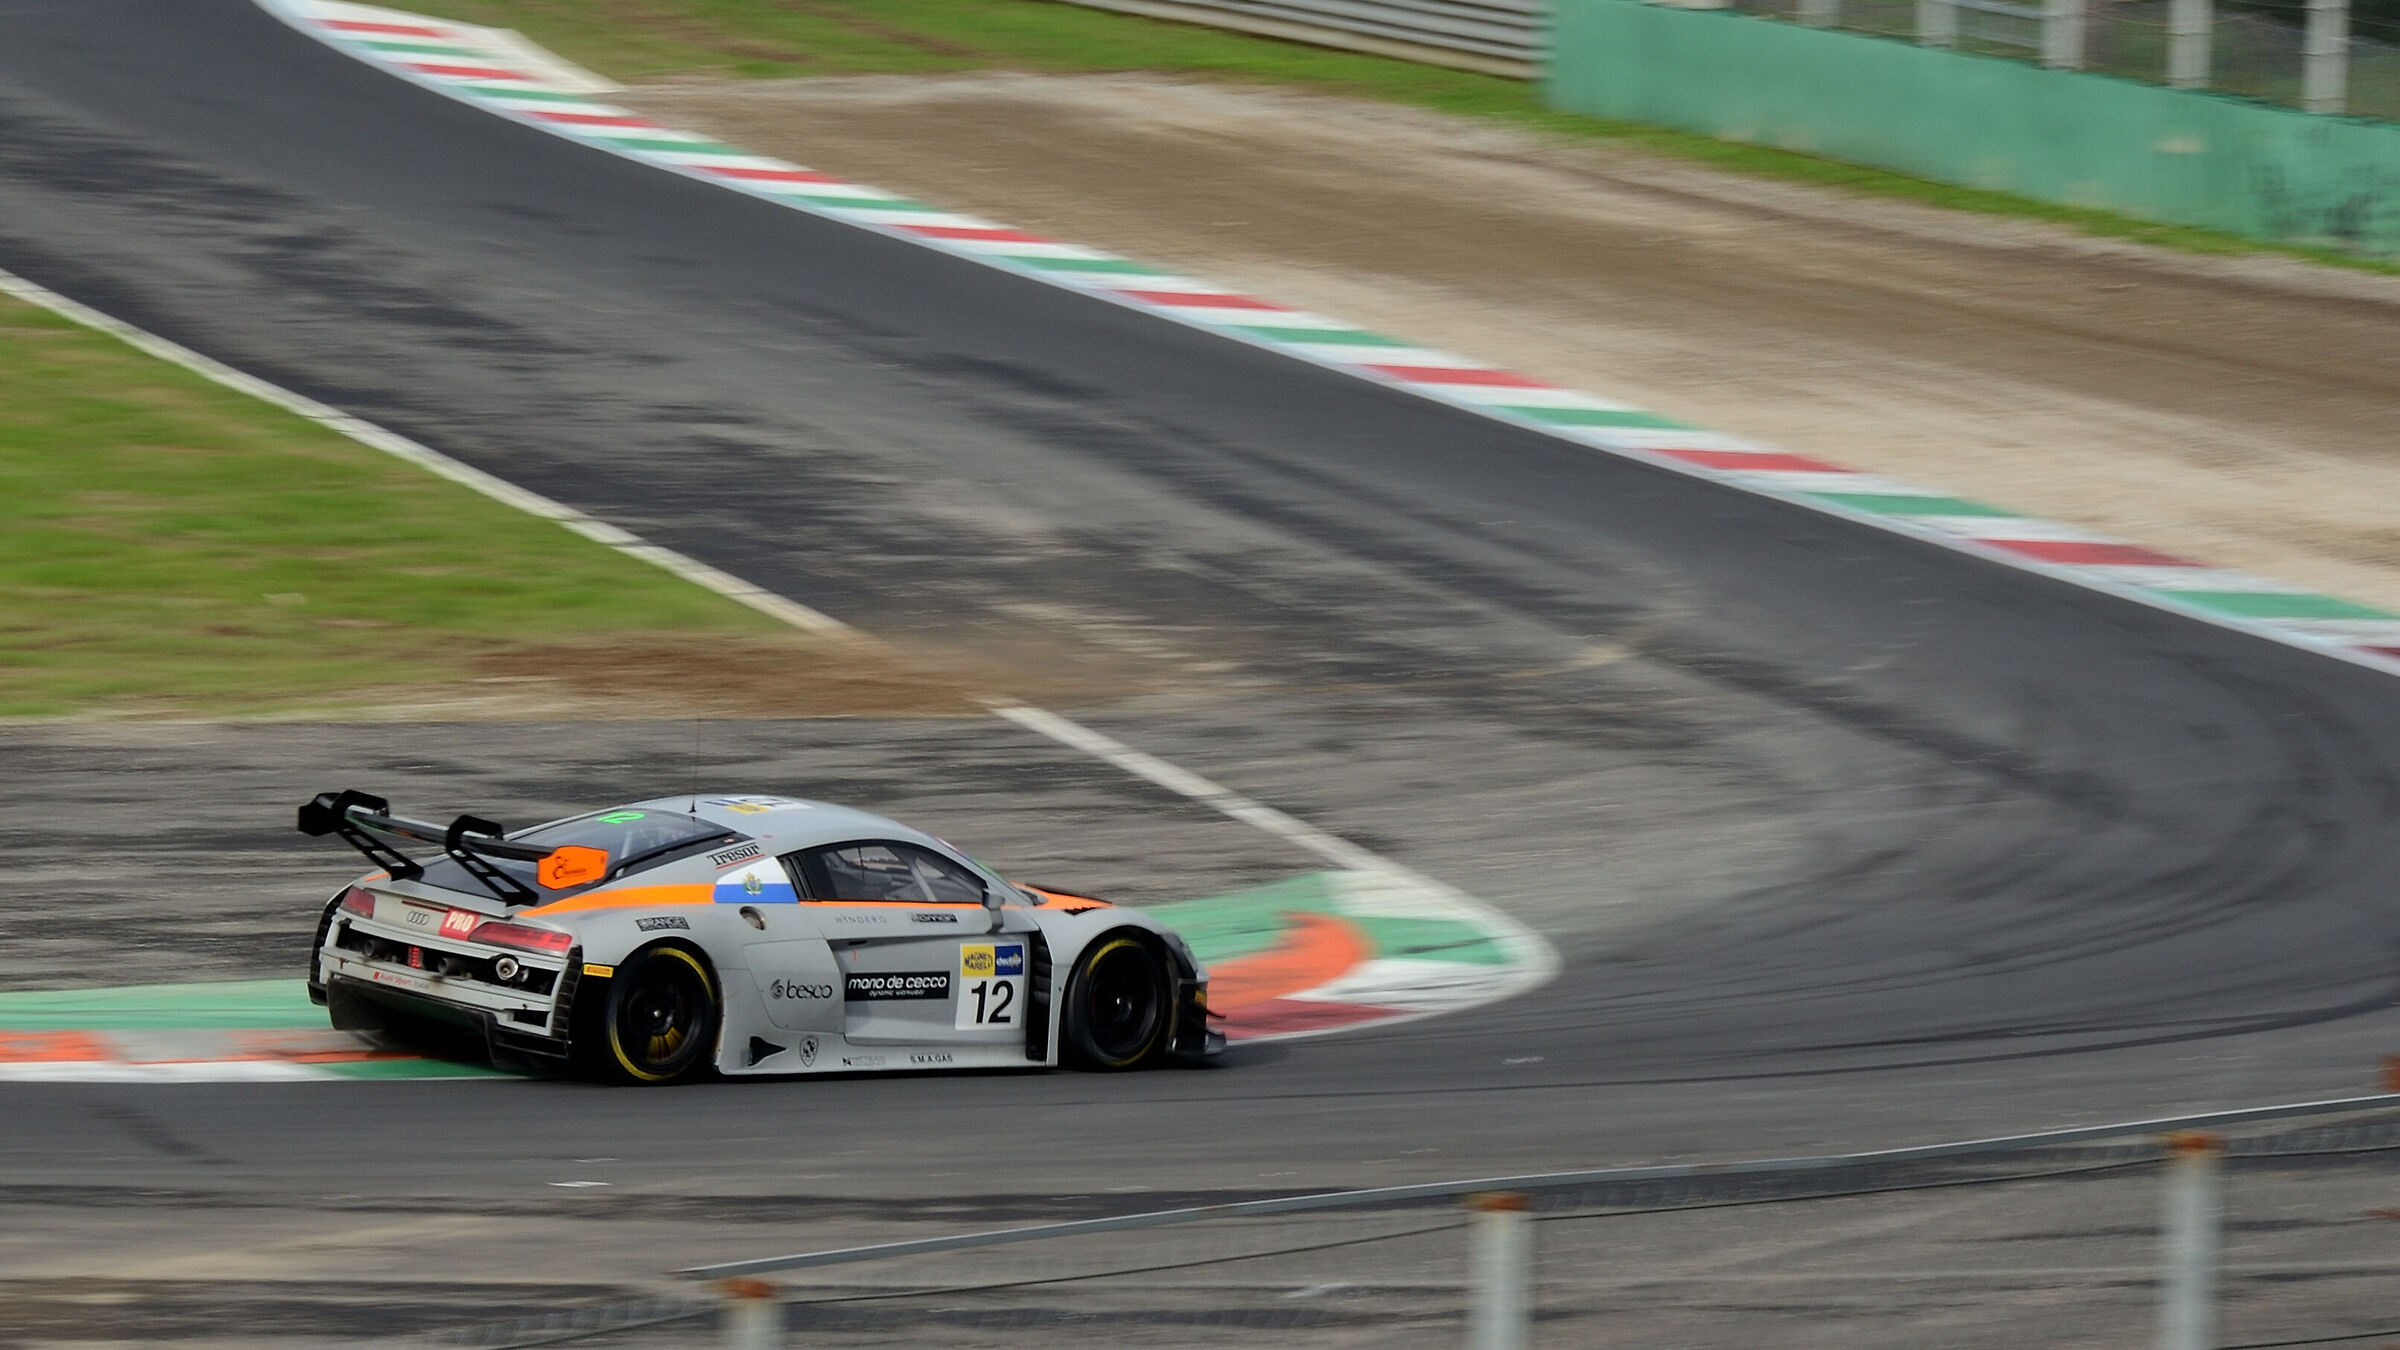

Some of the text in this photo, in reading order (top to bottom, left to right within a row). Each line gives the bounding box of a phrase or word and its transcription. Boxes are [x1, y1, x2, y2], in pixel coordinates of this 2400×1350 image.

[596, 811, 646, 825] 12
[706, 843, 760, 866] Tresor
[445, 910, 475, 932] PRO
[786, 979, 833, 999] besco
[886, 975, 904, 989] de
[906, 976, 948, 989] cecco
[971, 980, 1014, 1024] 12
